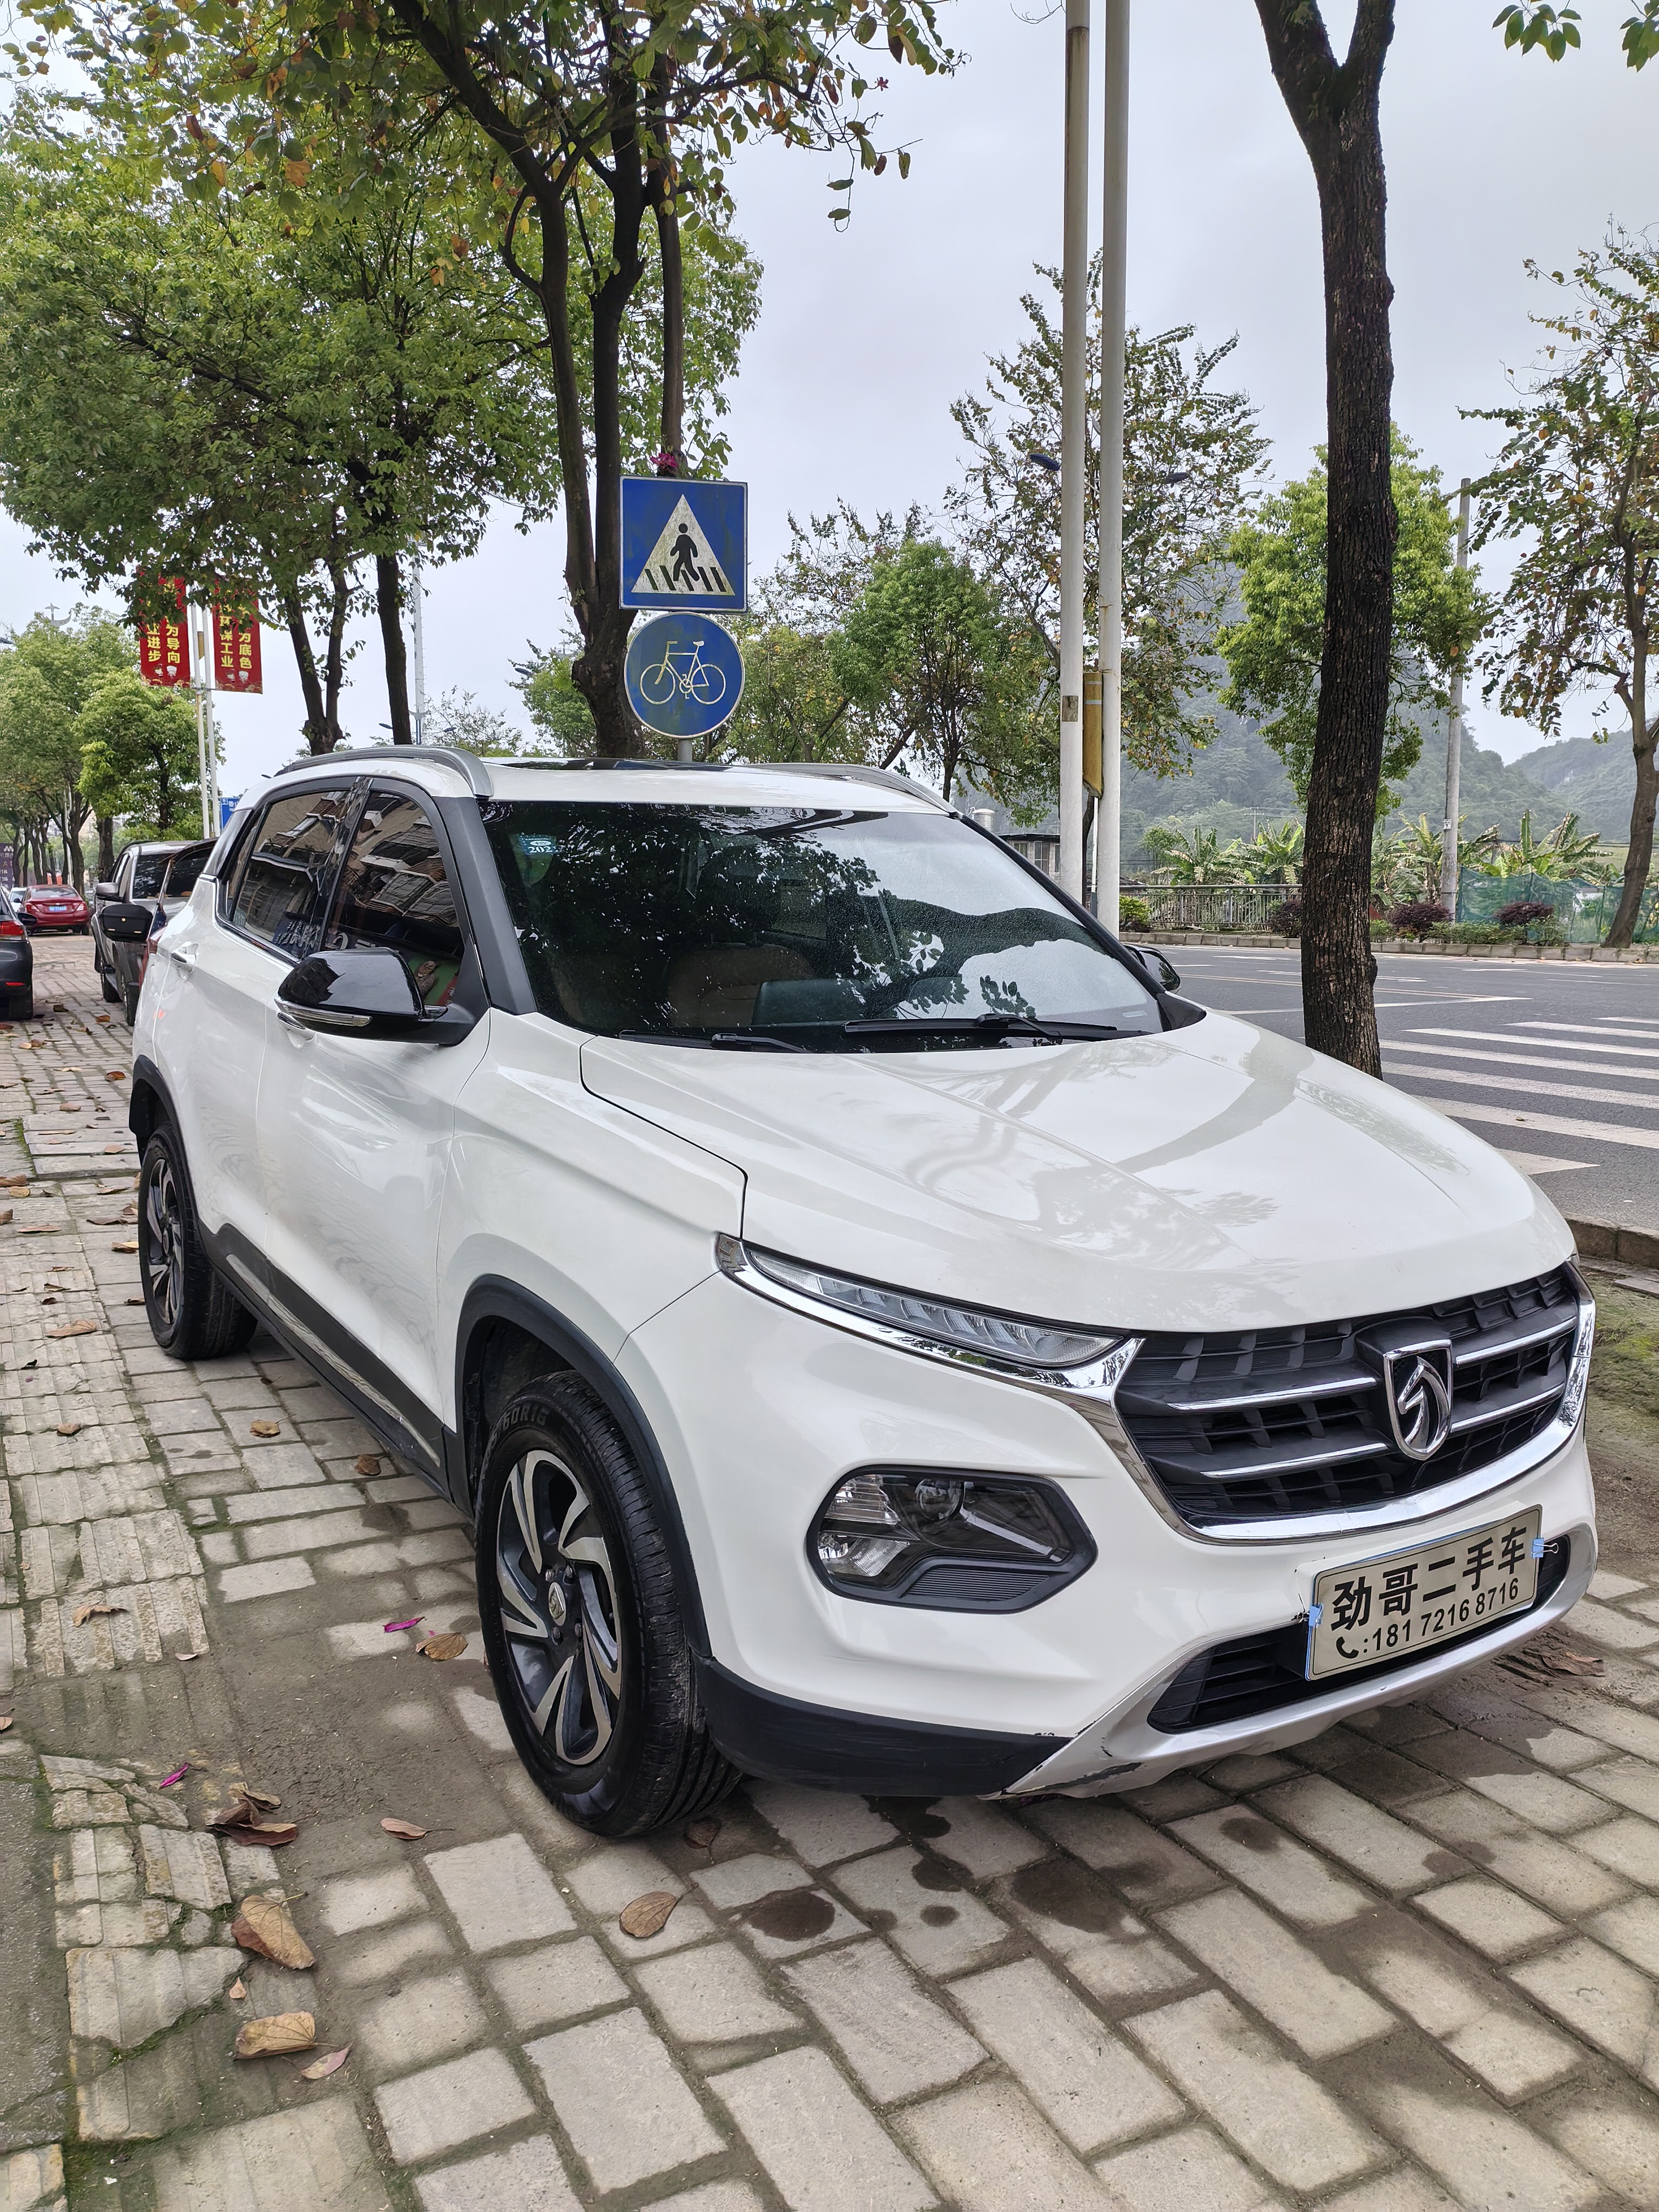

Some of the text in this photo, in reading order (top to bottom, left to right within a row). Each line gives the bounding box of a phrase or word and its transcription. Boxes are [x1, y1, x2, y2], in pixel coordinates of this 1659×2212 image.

[1331, 1526, 1527, 1632] 劲哥二手车
